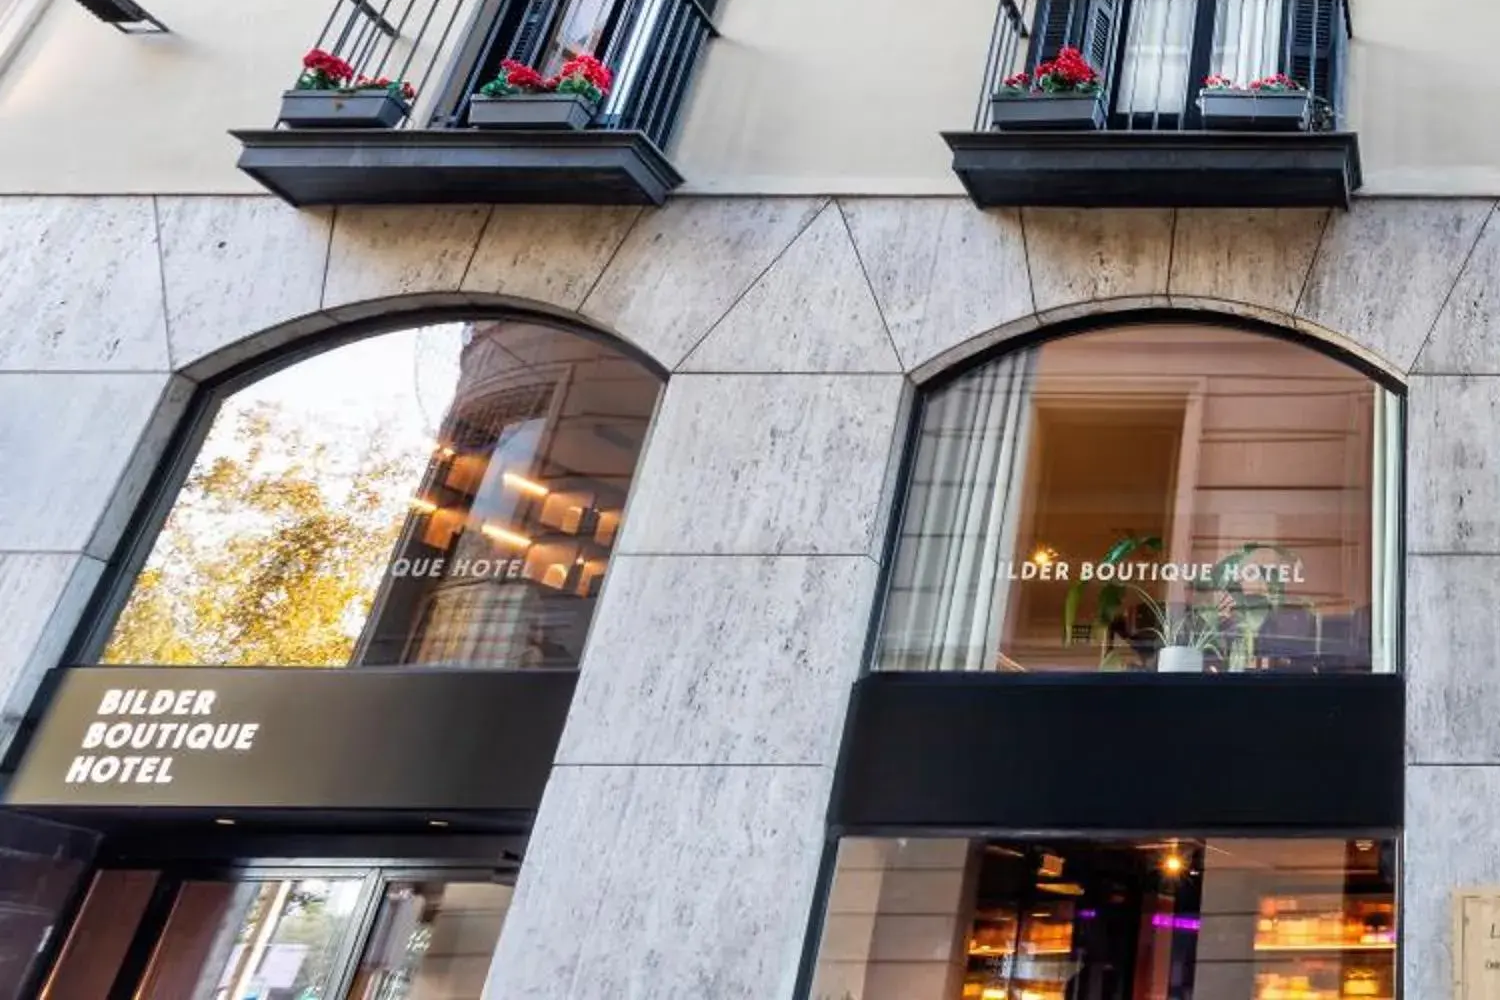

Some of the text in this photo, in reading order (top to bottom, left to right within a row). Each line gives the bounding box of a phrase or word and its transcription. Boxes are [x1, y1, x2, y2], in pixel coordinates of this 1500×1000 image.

[452, 558, 532, 578] HOTEL
[995, 561, 1305, 583] ILDER BOUTIQUE HOTEL
[97, 689, 217, 715] BILDER
[81, 721, 260, 749] BOUTIQUE
[65, 755, 174, 783] HOTEL
